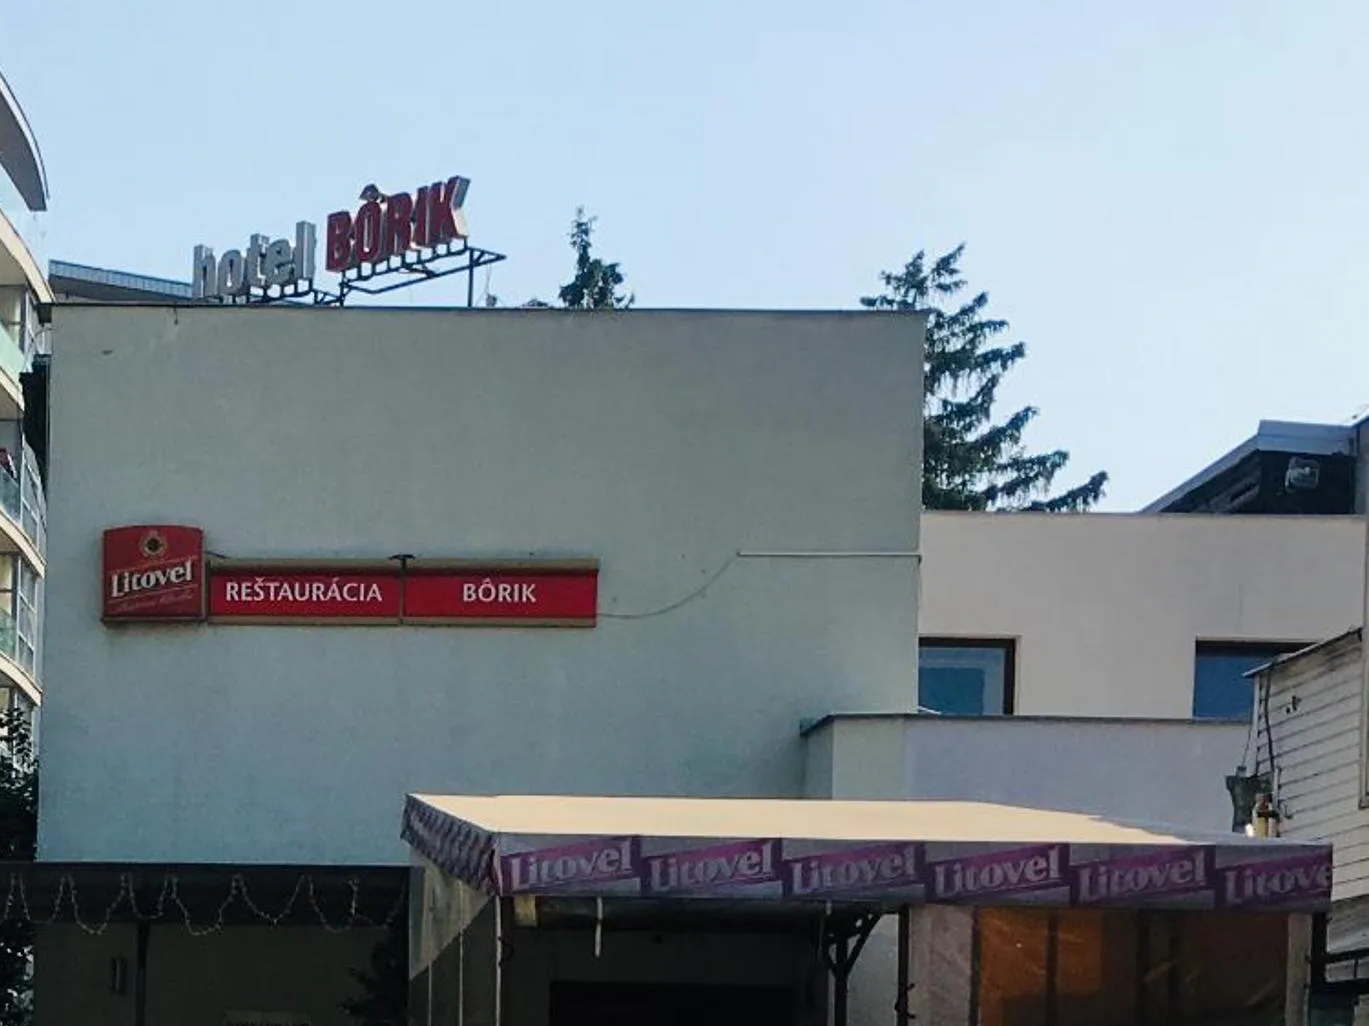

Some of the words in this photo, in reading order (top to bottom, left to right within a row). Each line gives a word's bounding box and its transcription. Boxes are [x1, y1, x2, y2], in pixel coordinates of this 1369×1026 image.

[193, 220, 317, 298] hotel
[325, 175, 471, 272] BÔRIK
[111, 560, 193, 597] Litovel
[225, 577, 383, 602] REŠTAURÁCIA
[462, 579, 537, 603] BÔRIK
[509, 842, 633, 891] Litovel
[647, 840, 775, 890] Litovel
[790, 845, 918, 894] Litovel
[934, 846, 1062, 897] Litovel
[1078, 849, 1207, 902] Litovel
[1224, 861, 1332, 904] Litove
